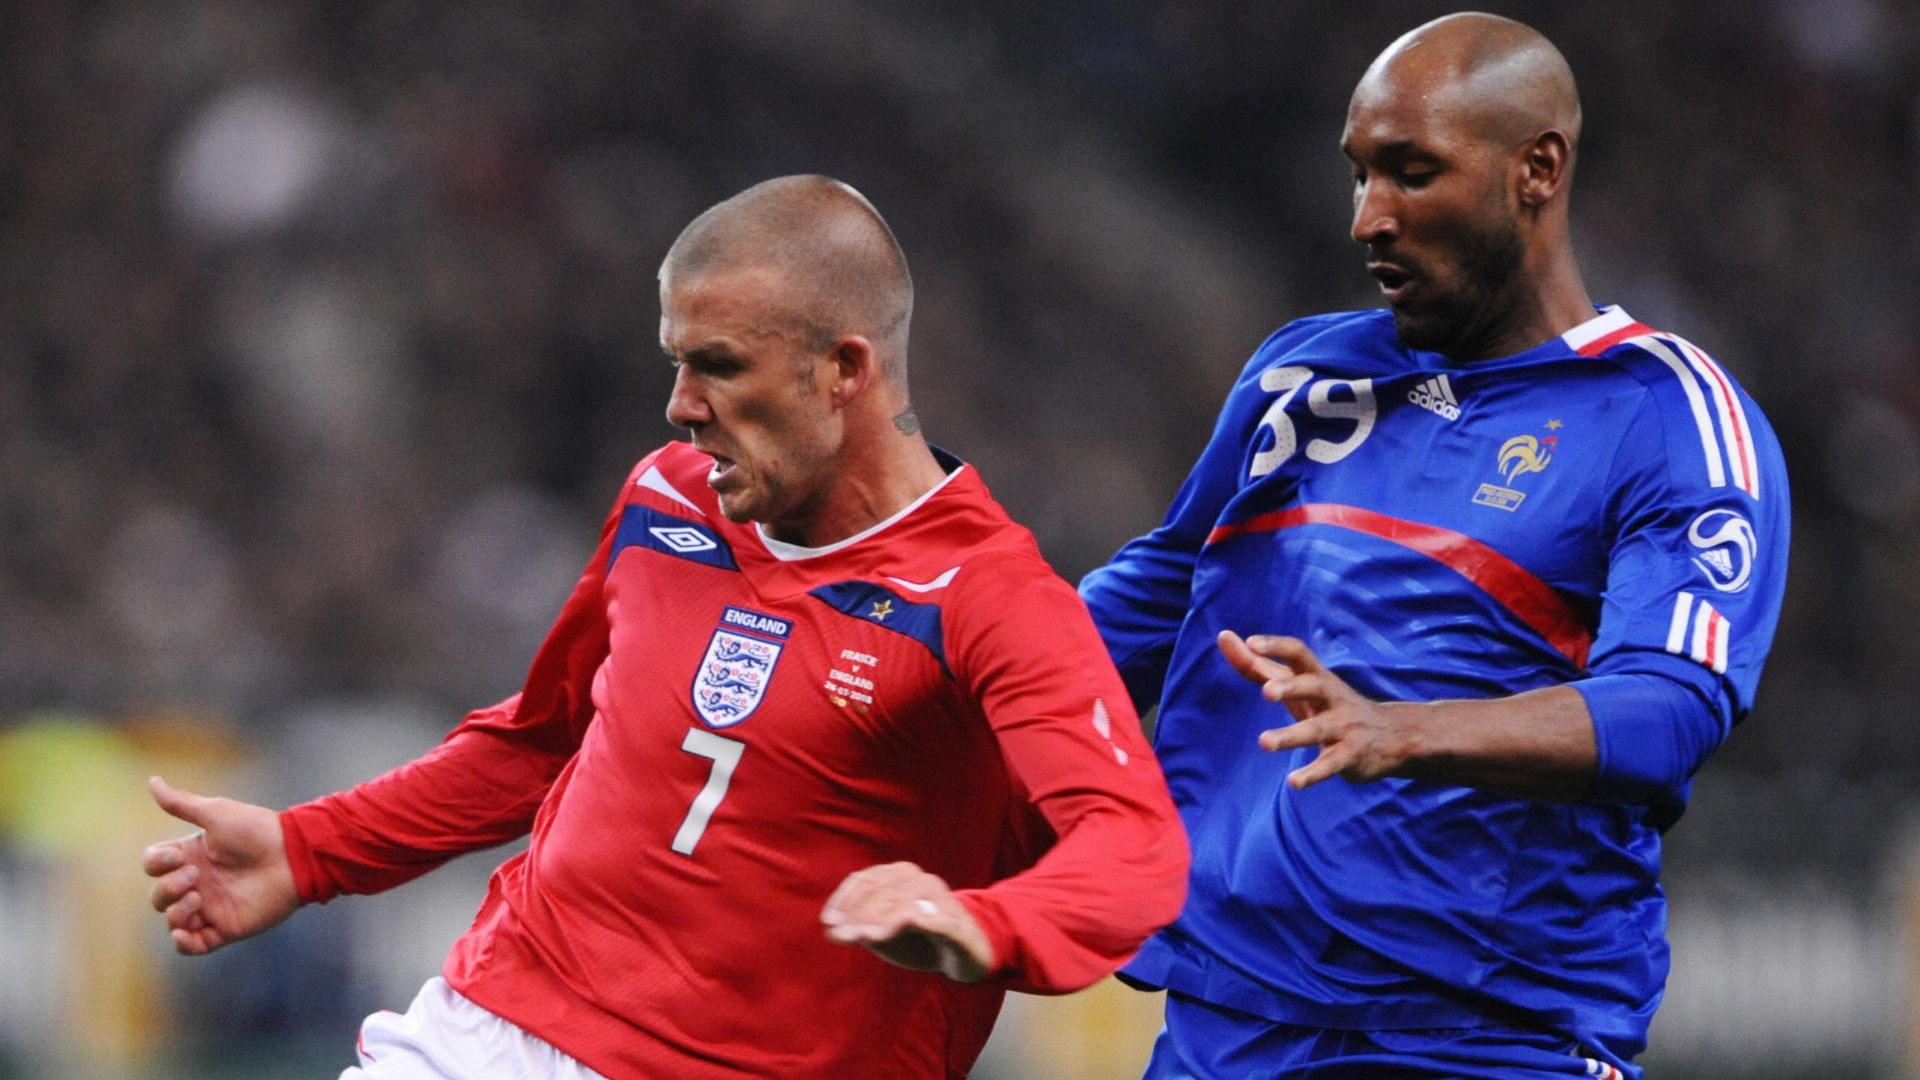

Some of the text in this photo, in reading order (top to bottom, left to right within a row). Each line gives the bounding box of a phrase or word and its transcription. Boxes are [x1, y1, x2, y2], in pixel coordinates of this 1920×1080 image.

[1408, 390, 1461, 421] adidas
[1249, 366, 1377, 477] 39
[725, 609, 787, 635] ENGLAND
[841, 650, 878, 667] FRANCE
[829, 669, 874, 691] ENGLAND
[671, 727, 746, 856] 7
